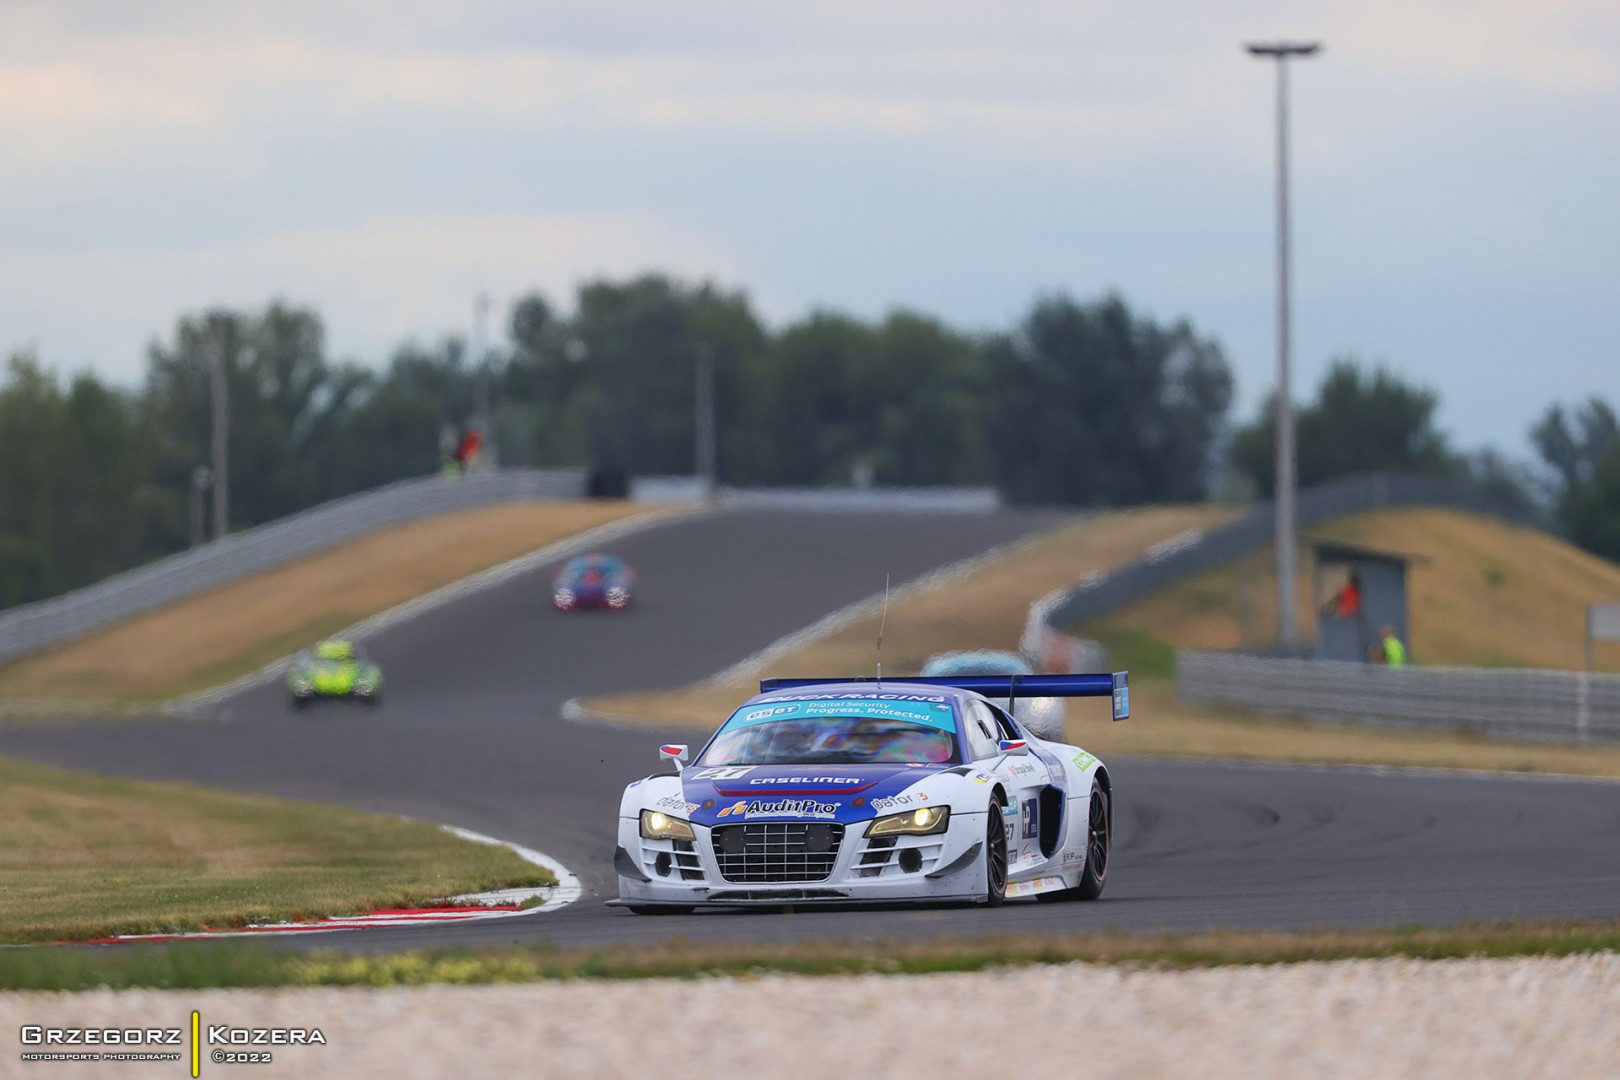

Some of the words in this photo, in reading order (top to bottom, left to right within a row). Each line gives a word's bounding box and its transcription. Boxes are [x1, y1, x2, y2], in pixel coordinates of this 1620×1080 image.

[808, 701, 844, 709] Digital
[867, 708, 933, 722] Protected.
[696, 767, 752, 779] 27
[750, 777, 860, 785] CASELINER
[747, 799, 836, 813] AuditPro
